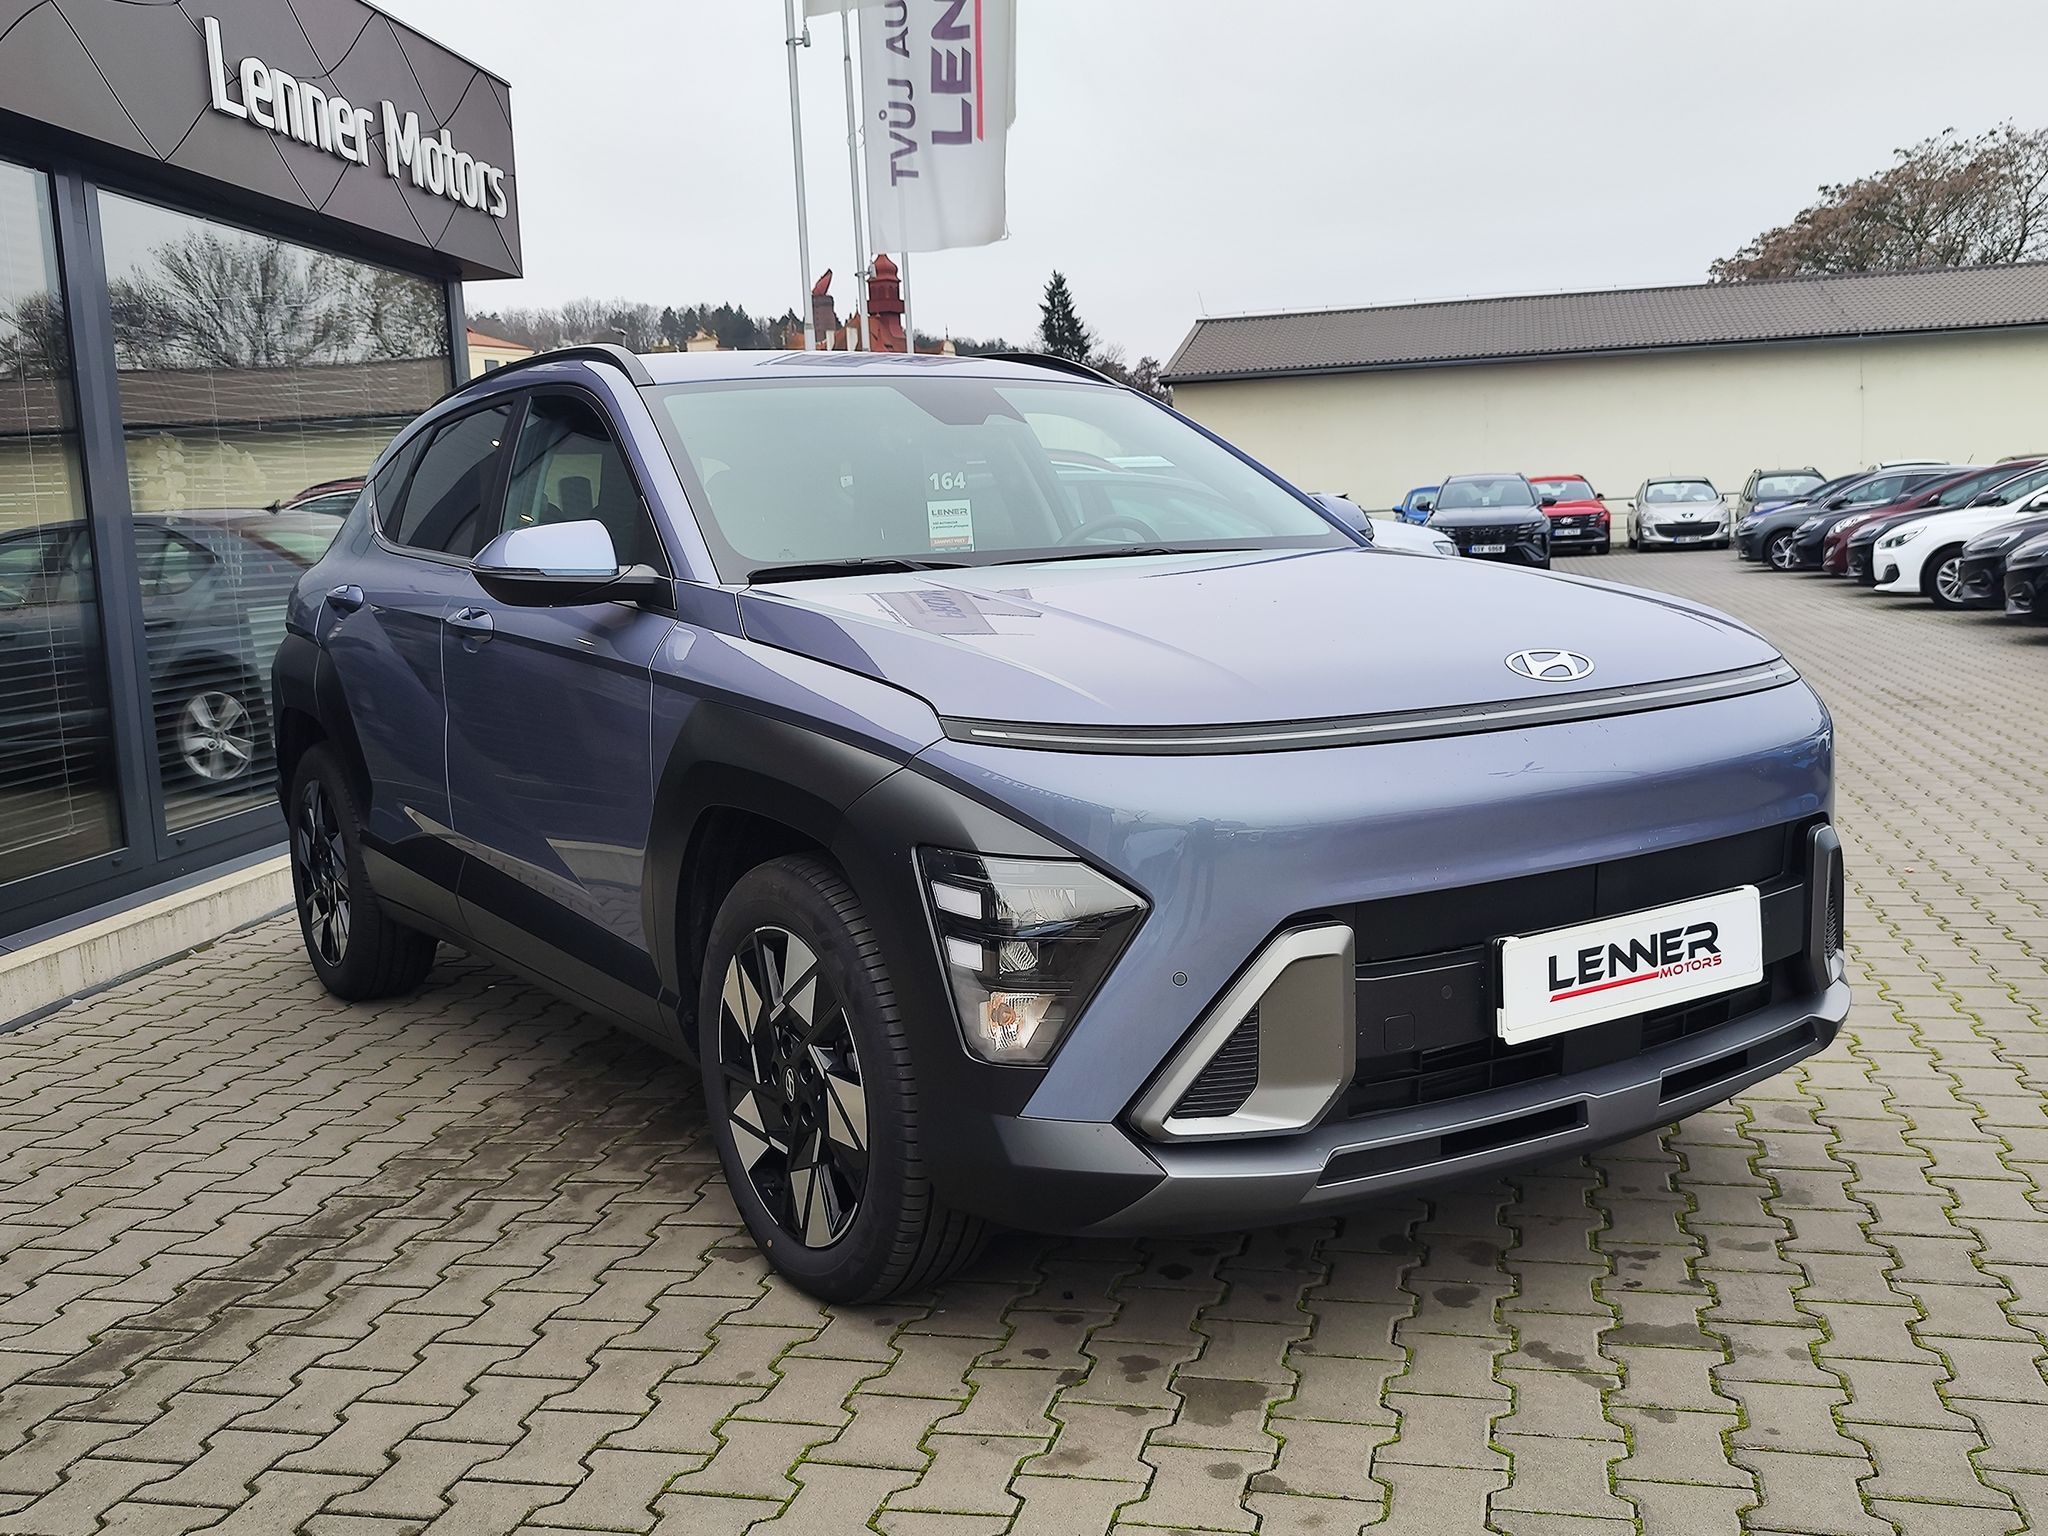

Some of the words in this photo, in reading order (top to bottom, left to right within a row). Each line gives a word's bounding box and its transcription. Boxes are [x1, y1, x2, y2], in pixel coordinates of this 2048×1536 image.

[203, 16, 374, 167] Lenner
[380, 100, 508, 218] Motors
[879, 78, 919, 187] TVŮJ
[929, 471, 967, 490] 164
[931, 508, 968, 516] LENNER
[1548, 921, 1721, 992] LENNER
[1659, 954, 1722, 979] MOTORS
